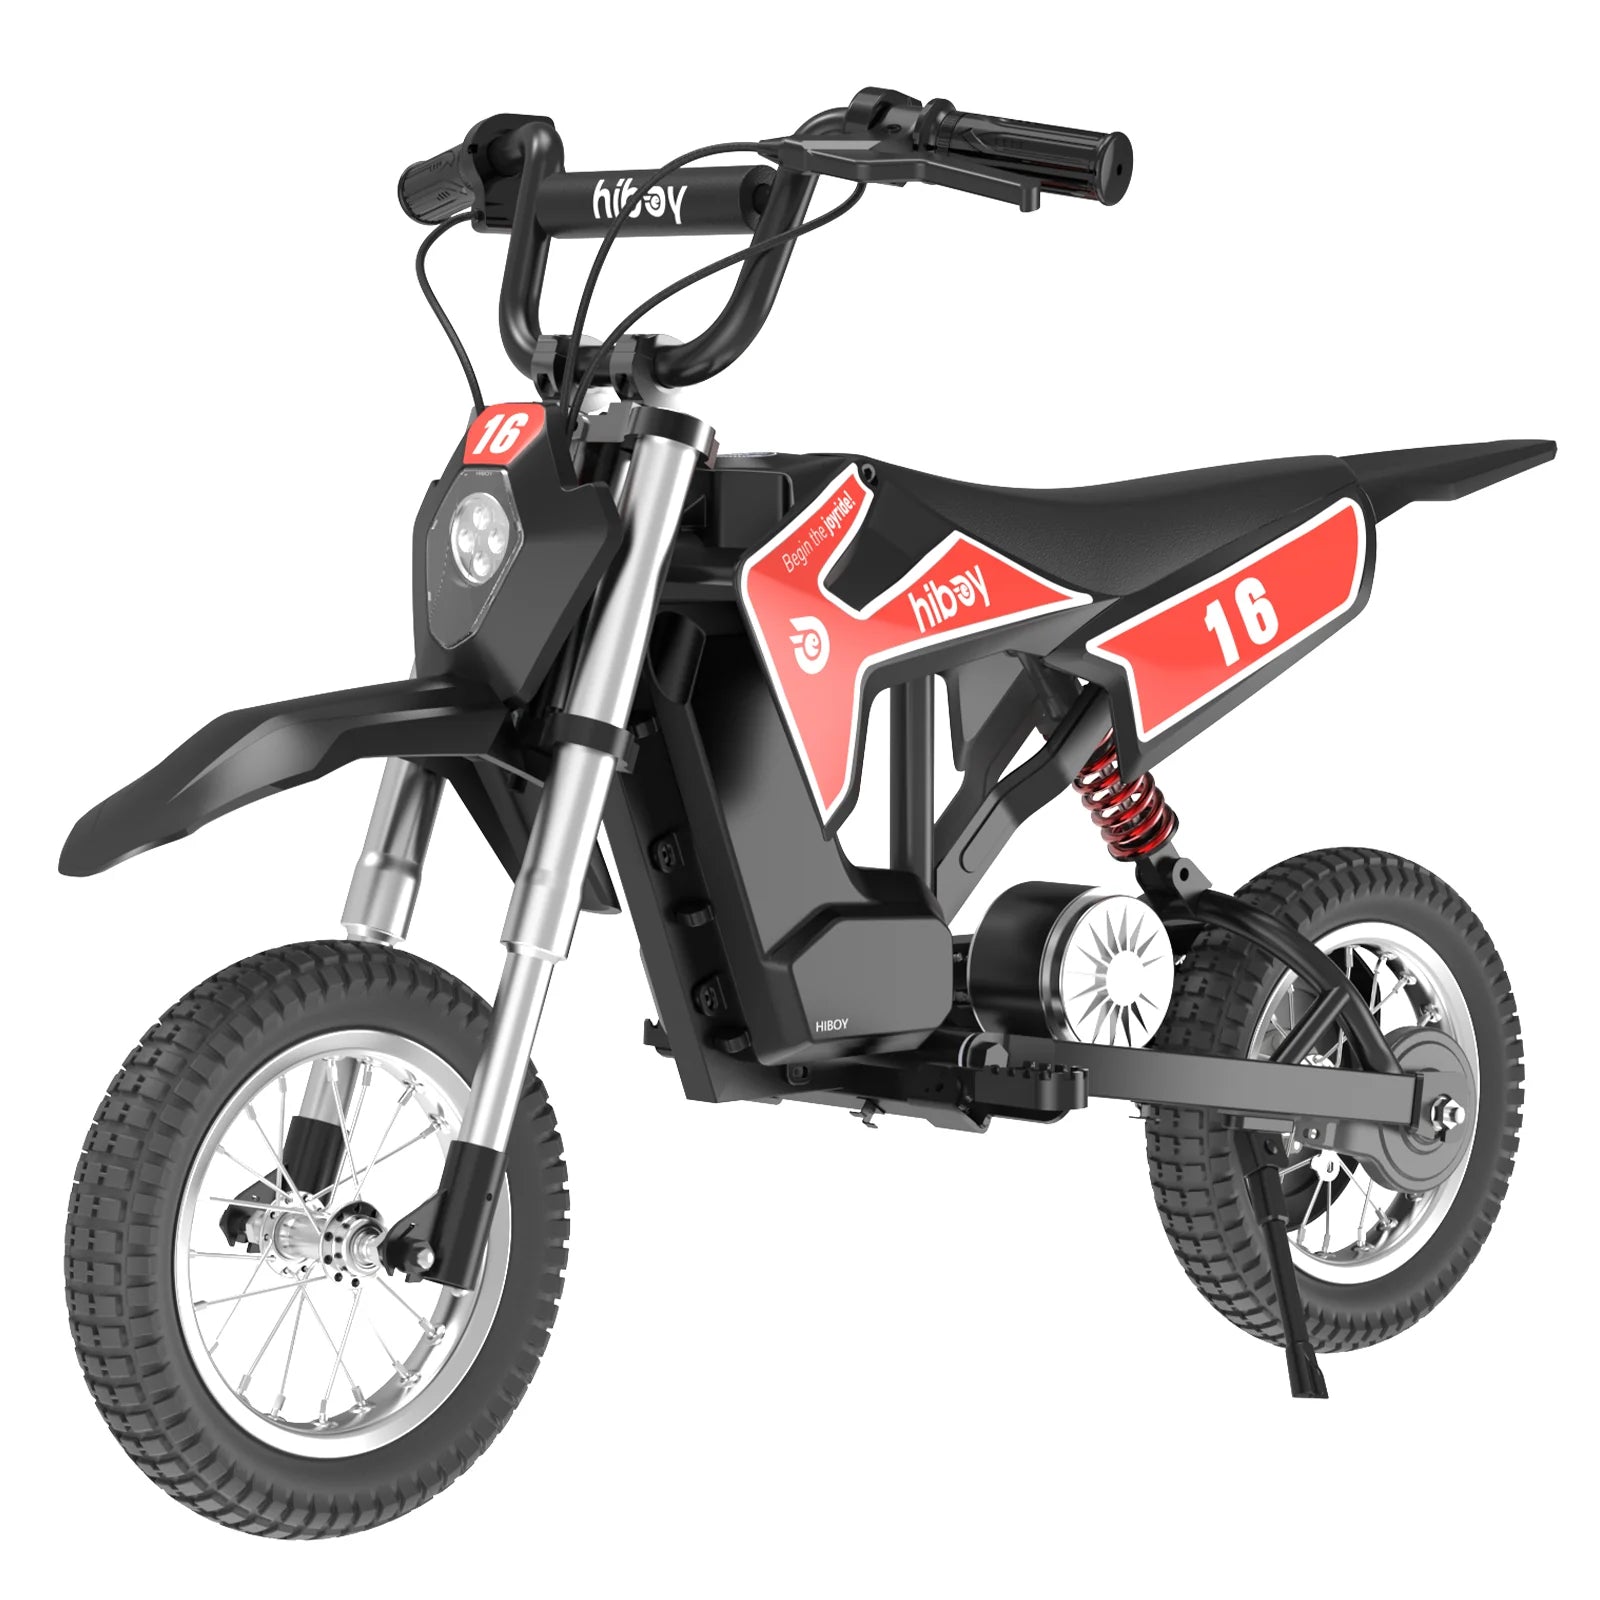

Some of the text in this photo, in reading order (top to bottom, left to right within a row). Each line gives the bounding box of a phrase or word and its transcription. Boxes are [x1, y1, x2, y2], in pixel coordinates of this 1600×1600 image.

[472, 412, 529, 455] 16
[781, 490, 857, 573] Begin the joyride!
[907, 564, 991, 634] hiboy
[1204, 577, 1279, 667] 16
[815, 1017, 849, 1033] HIBOY
